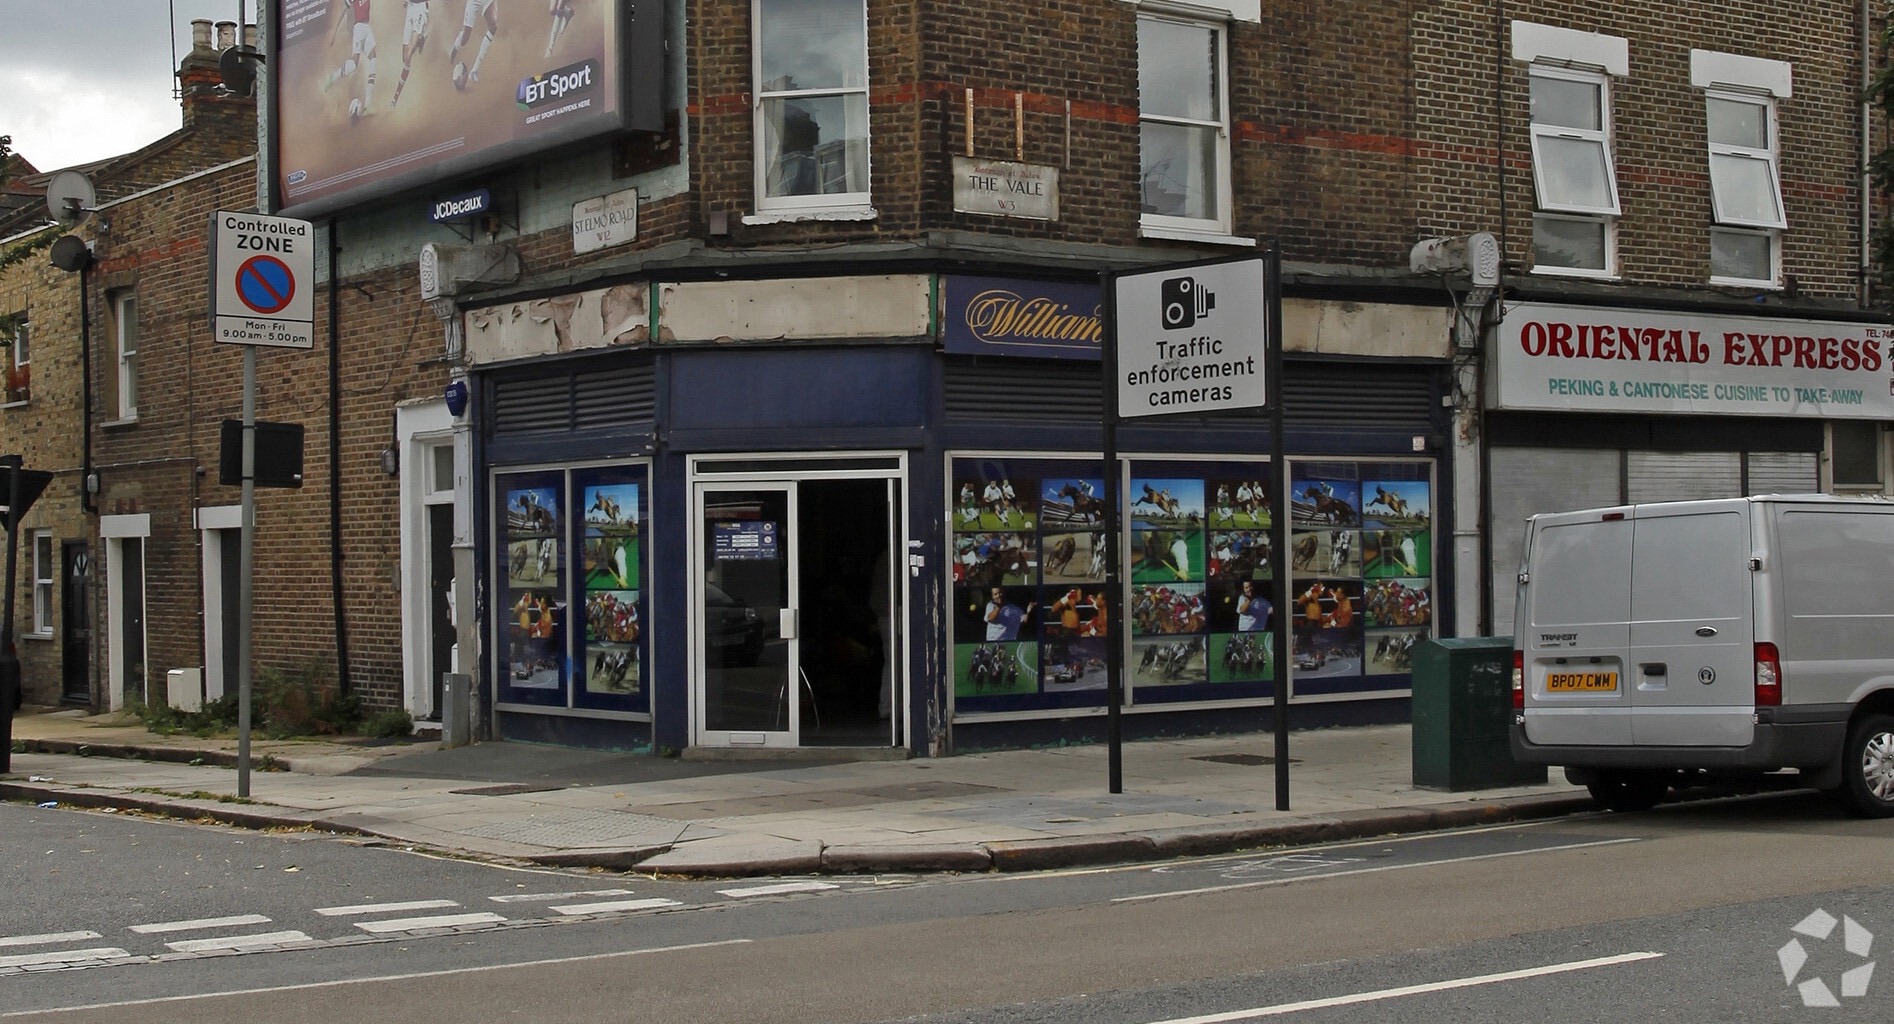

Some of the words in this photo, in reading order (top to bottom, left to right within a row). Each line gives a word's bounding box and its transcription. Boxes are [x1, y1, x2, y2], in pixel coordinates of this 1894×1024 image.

[526, 80, 548, 104] BT
[550, 65, 591, 98] Sport
[969, 175, 999, 191] THE
[1006, 180, 1043, 196] VALE
[433, 195, 482, 220] JCDecaux
[998, 199, 1016, 211] W3
[609, 207, 635, 225] ROAD
[226, 217, 305, 236] Controlled
[237, 234, 294, 253] ZONE
[1156, 336, 1223, 359] Traffic
[1521, 322, 1710, 364] ORIENTAL
[1723, 332, 1882, 372] EXPRESS
[1127, 355, 1255, 386] enforcement
[1149, 386, 1233, 406] cameras
[1549, 378, 1604, 396] PEKING
[1609, 380, 1619, 397] &
[1623, 380, 1709, 400] CANTONESE
[1714, 384, 1768, 401] CUISINE
[1772, 387, 1790, 402] TO
[1541, 633, 1578, 641] TRANSIT
[1551, 674, 1583, 687] BP07
